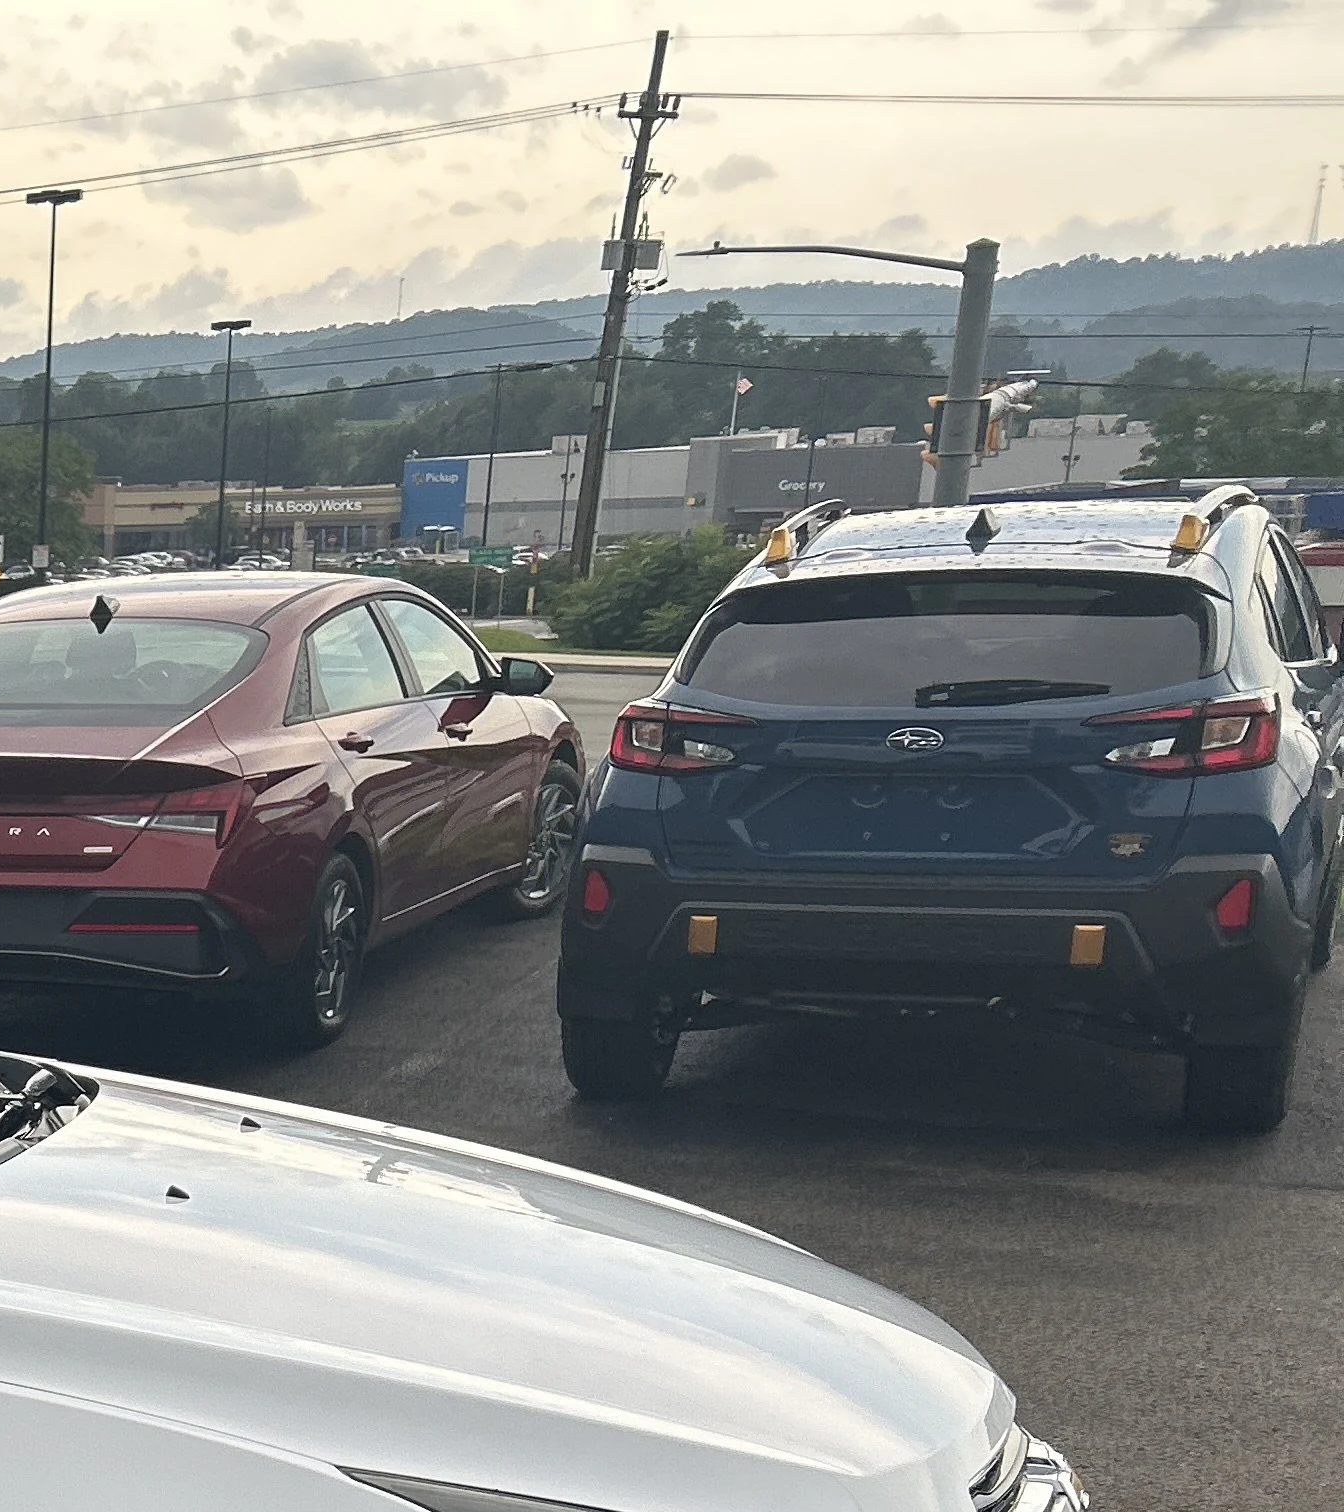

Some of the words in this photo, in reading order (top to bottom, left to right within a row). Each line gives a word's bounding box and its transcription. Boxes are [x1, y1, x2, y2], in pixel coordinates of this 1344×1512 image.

[425, 472, 460, 484] Pickup
[778, 479, 826, 493] Grocry
[275, 501, 286, 513] &
[286, 500, 319, 515] Body
[319, 499, 362, 512] Works
